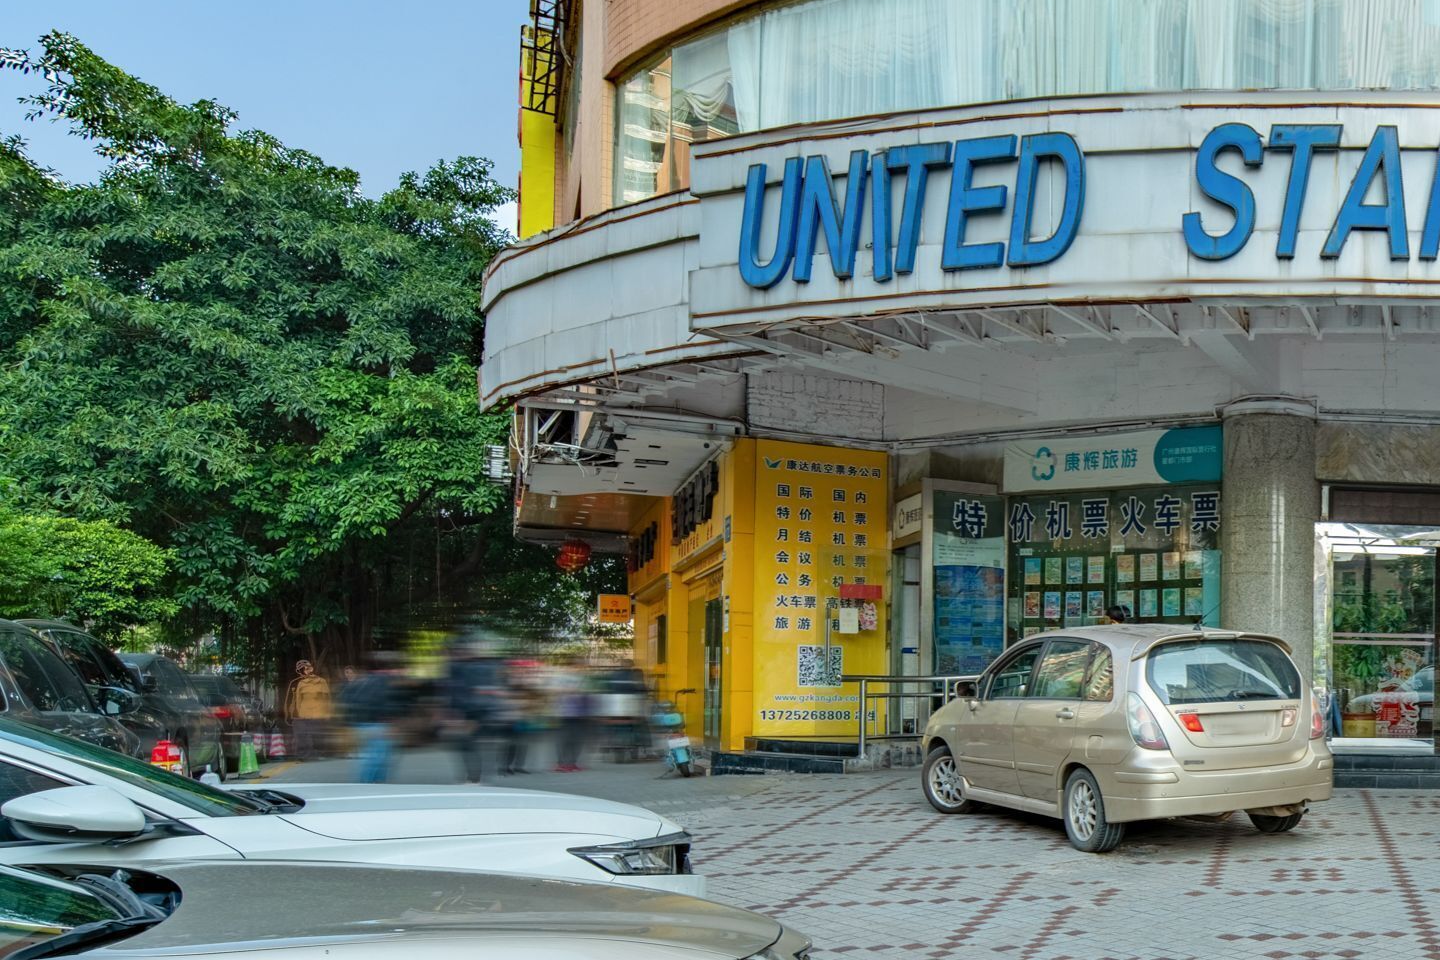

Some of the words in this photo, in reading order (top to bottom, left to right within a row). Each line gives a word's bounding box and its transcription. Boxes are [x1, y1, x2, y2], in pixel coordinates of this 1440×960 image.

[738, 131, 1086, 290] UNITED
[786, 460, 881, 478] 康达航空票务公司
[1064, 448, 1138, 472] 康辉旅游
[777, 484, 813, 499] 国际
[833, 489, 866, 503] 国内
[776, 506, 812, 520] 特价
[832, 511, 866, 524] 机票
[952, 491, 1221, 543] 特价机票火车票
[776, 528, 812, 542] 月结
[832, 533, 866, 546] 机票
[776, 550, 812, 564] 会议
[832, 555, 866, 567] 机票
[775, 573, 812, 587] 公务
[776, 595, 816, 609] 火车票
[775, 617, 811, 630] 旅游
[760, 710, 851, 721] 13725268808
